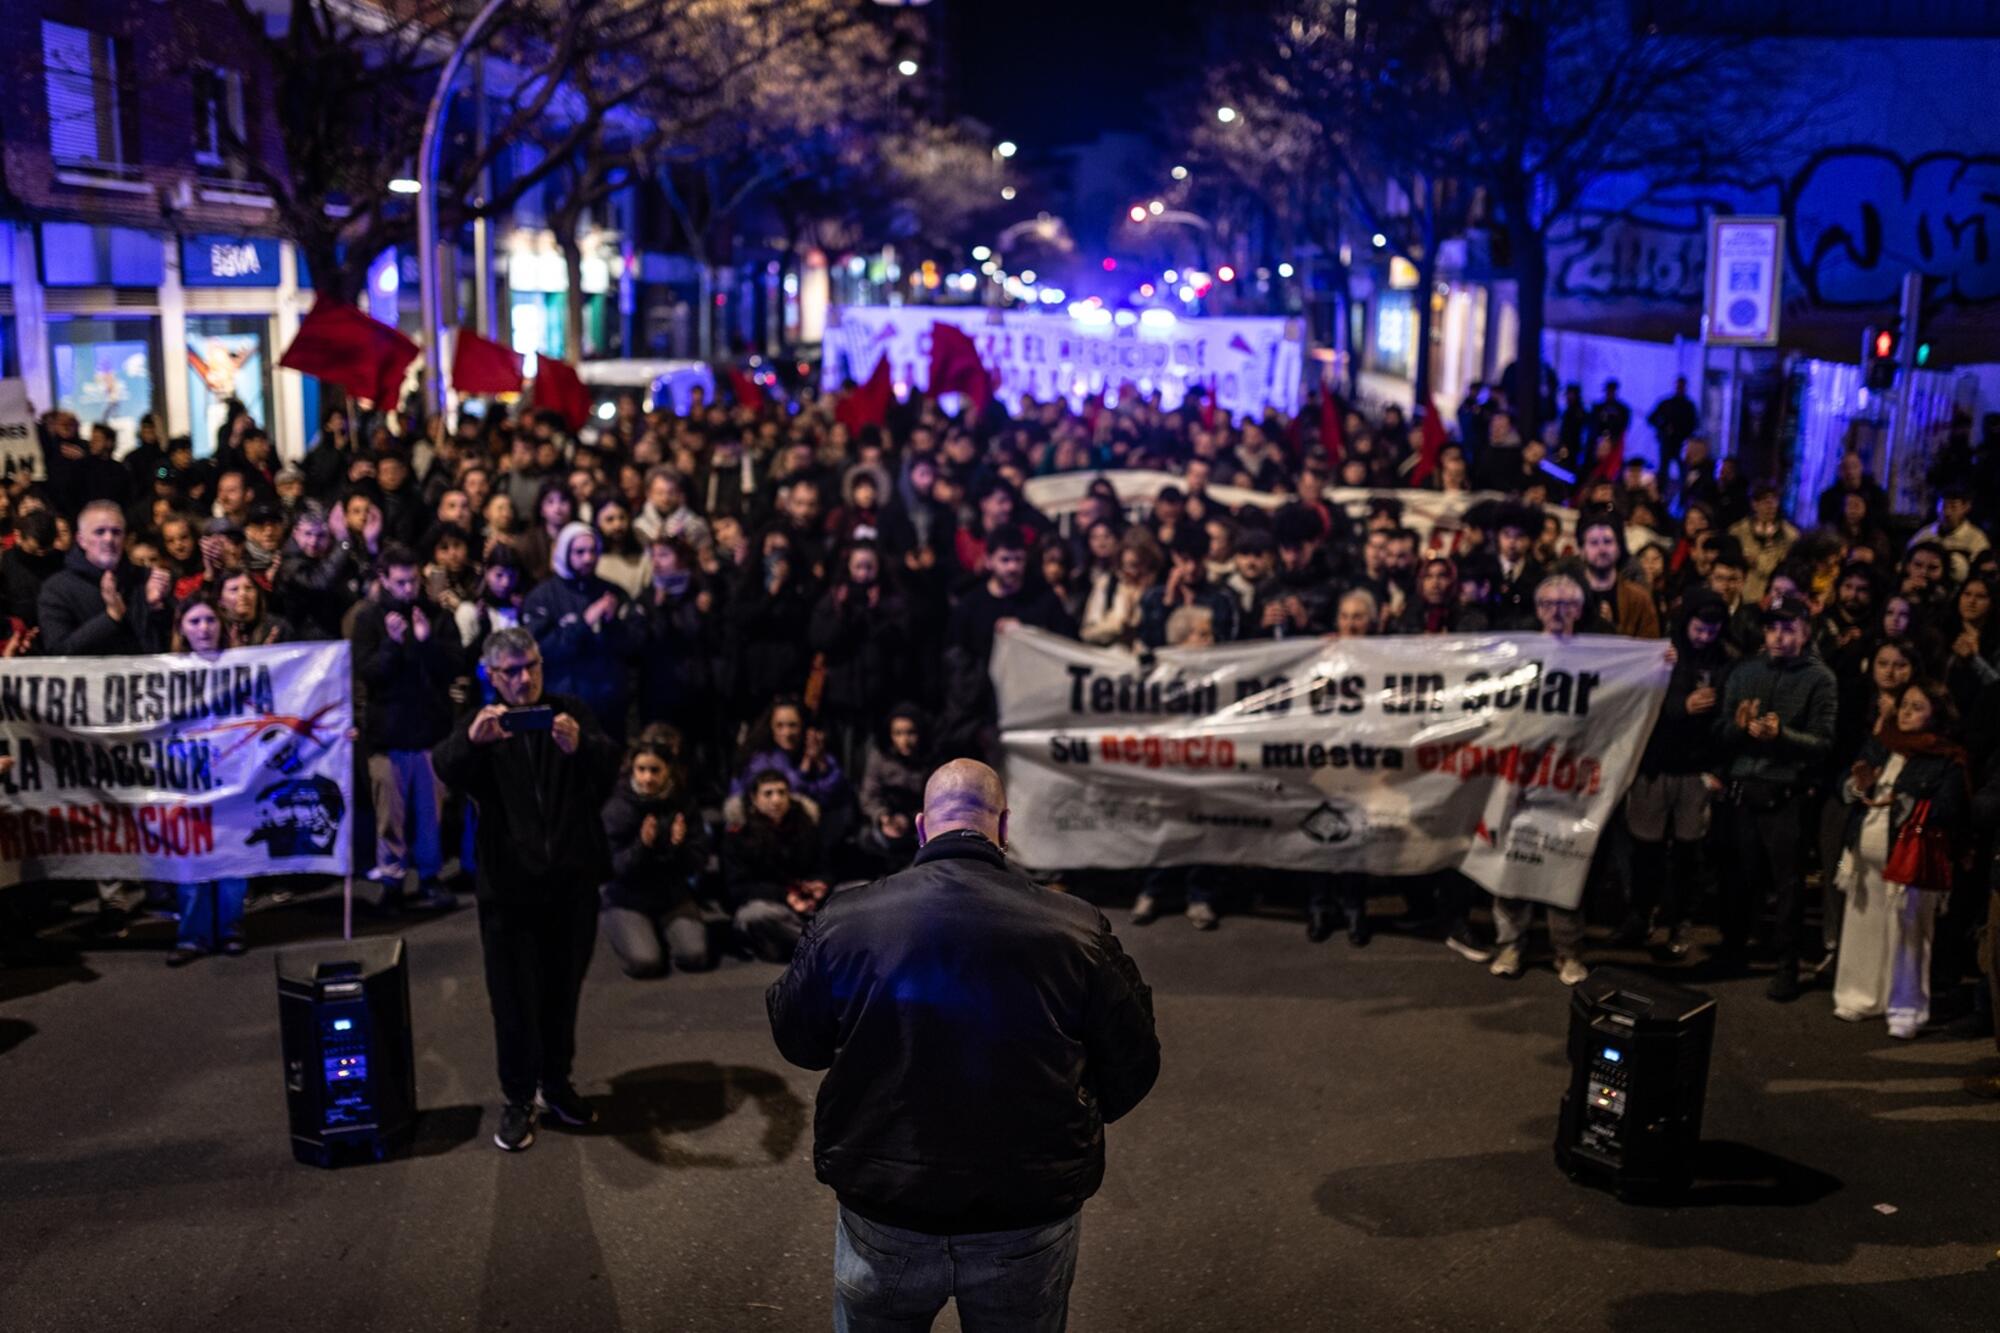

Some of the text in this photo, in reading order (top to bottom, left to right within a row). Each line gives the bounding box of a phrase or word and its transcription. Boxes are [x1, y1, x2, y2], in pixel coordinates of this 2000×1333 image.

[103, 664, 275, 724] DESOKUPA
[1234, 674, 1293, 716] no
[1309, 674, 1365, 715] es
[1383, 671, 1445, 713] un
[1462, 660, 1600, 717] solar
[1051, 734, 1090, 764] Su
